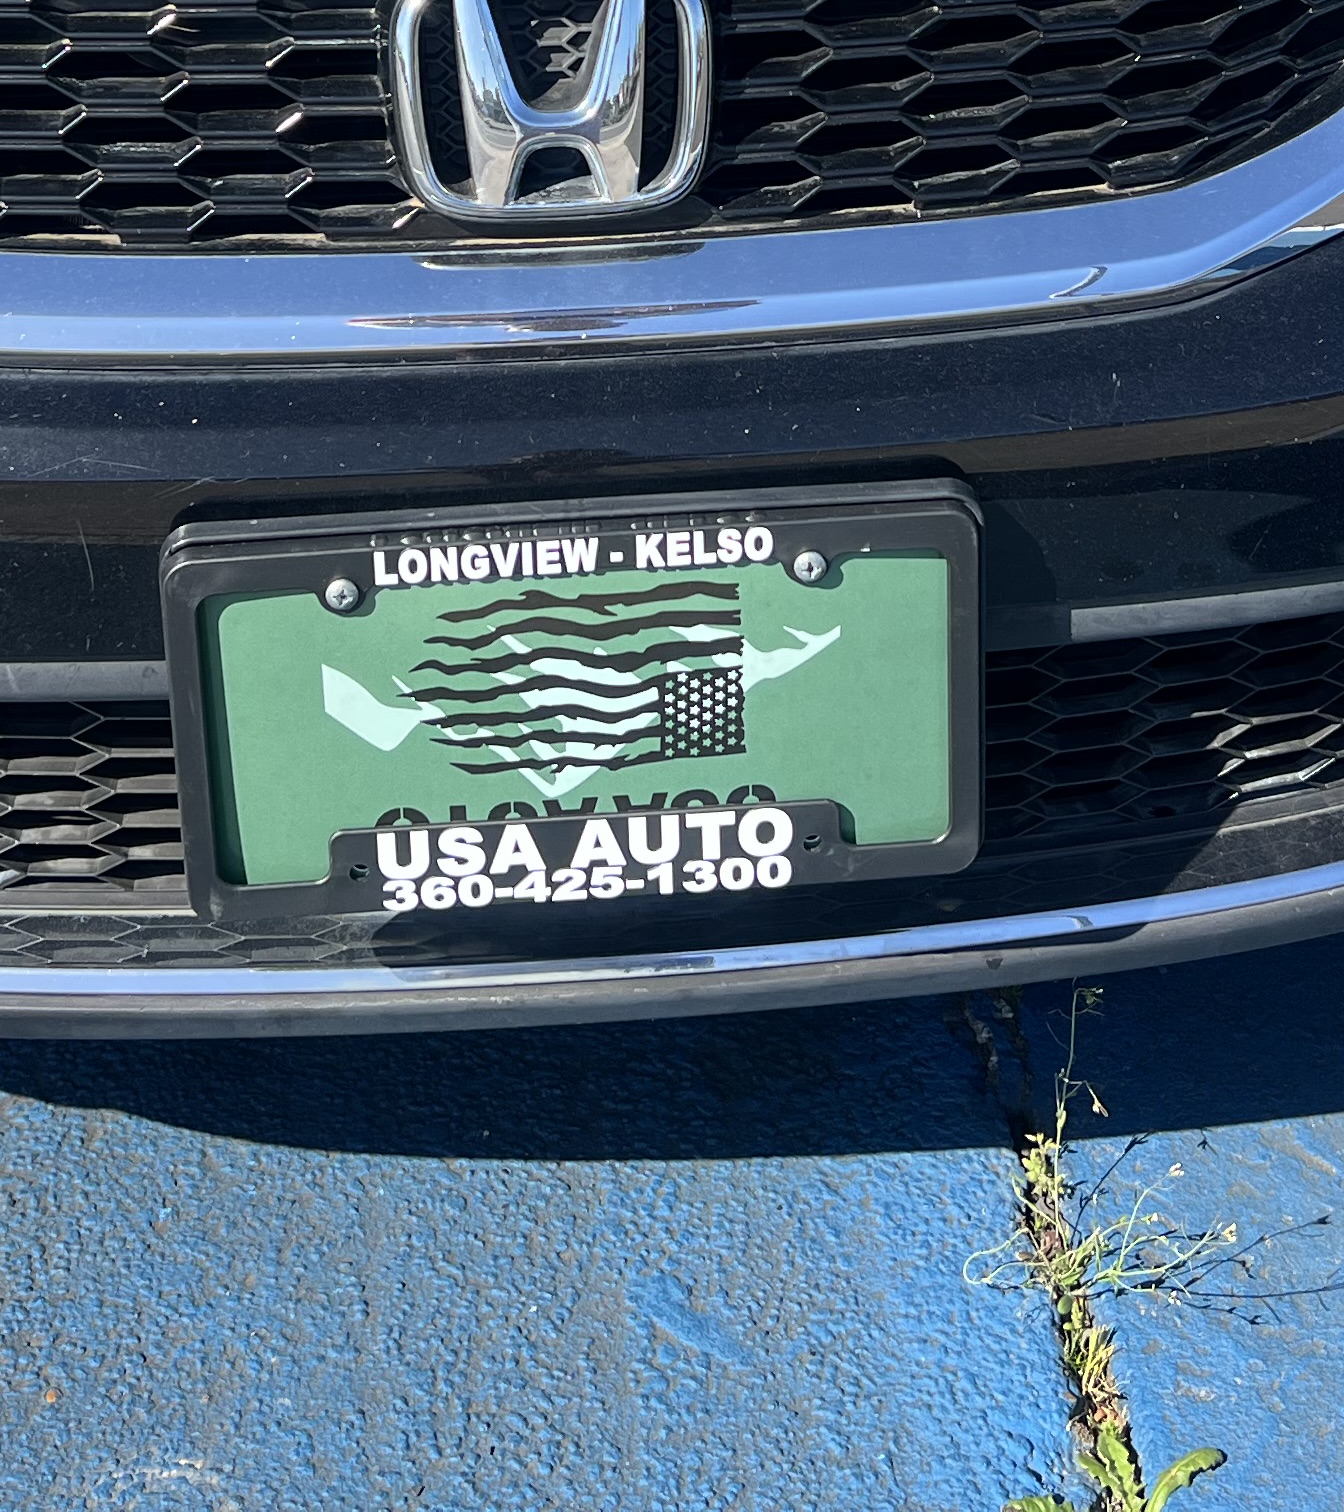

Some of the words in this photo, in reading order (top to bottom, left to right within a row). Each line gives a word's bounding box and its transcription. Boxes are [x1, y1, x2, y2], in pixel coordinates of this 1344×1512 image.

[373, 537, 599, 585] LONGVIEW
[635, 526, 774, 569] KELSO
[376, 822, 547, 881] USA
[570, 807, 794, 870] AUTO
[382, 855, 794, 912] 360-425-1300
